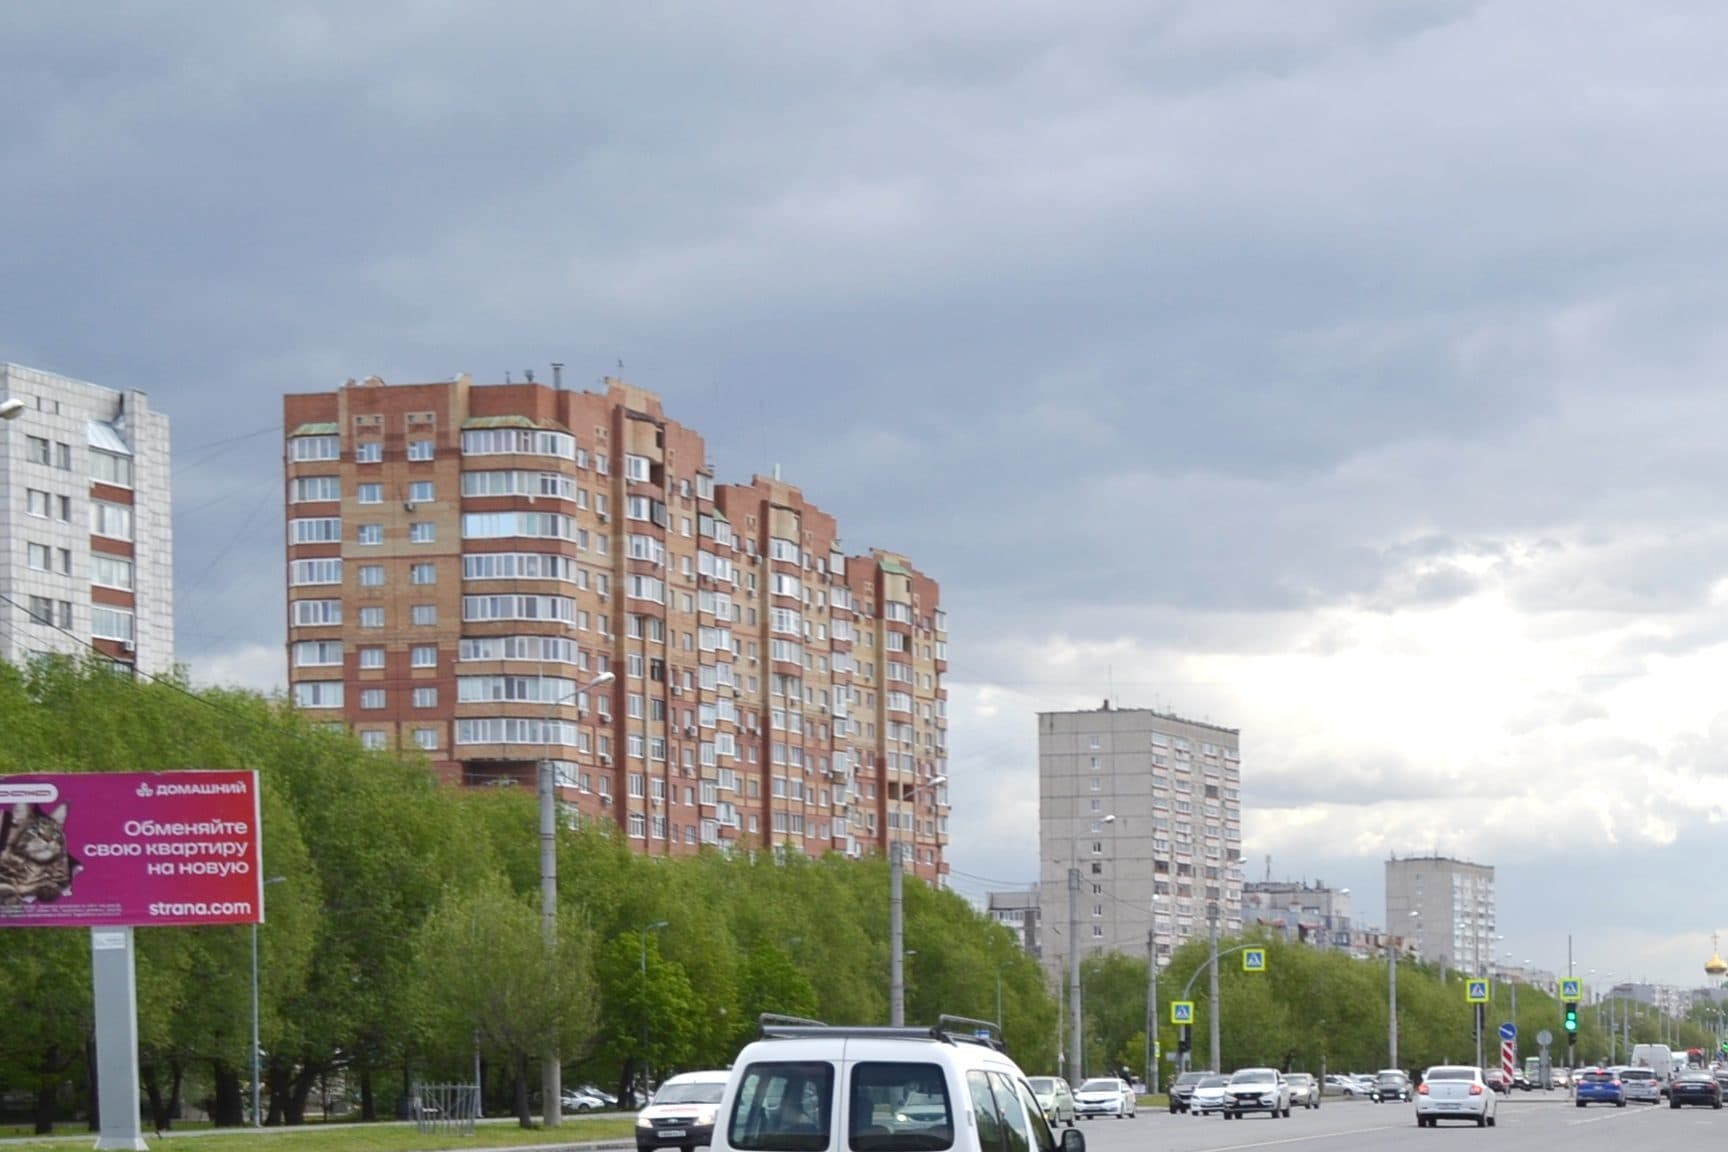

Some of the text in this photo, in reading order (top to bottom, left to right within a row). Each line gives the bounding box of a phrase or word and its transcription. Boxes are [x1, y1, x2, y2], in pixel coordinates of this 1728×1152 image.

[156, 780, 247, 796] ДОМАШНИЙ
[124, 818, 248, 837] Обменяйте
[83, 841, 248, 858] свою квартиру
[147, 861, 249, 877] на новую
[149, 900, 252, 916] strana.com
